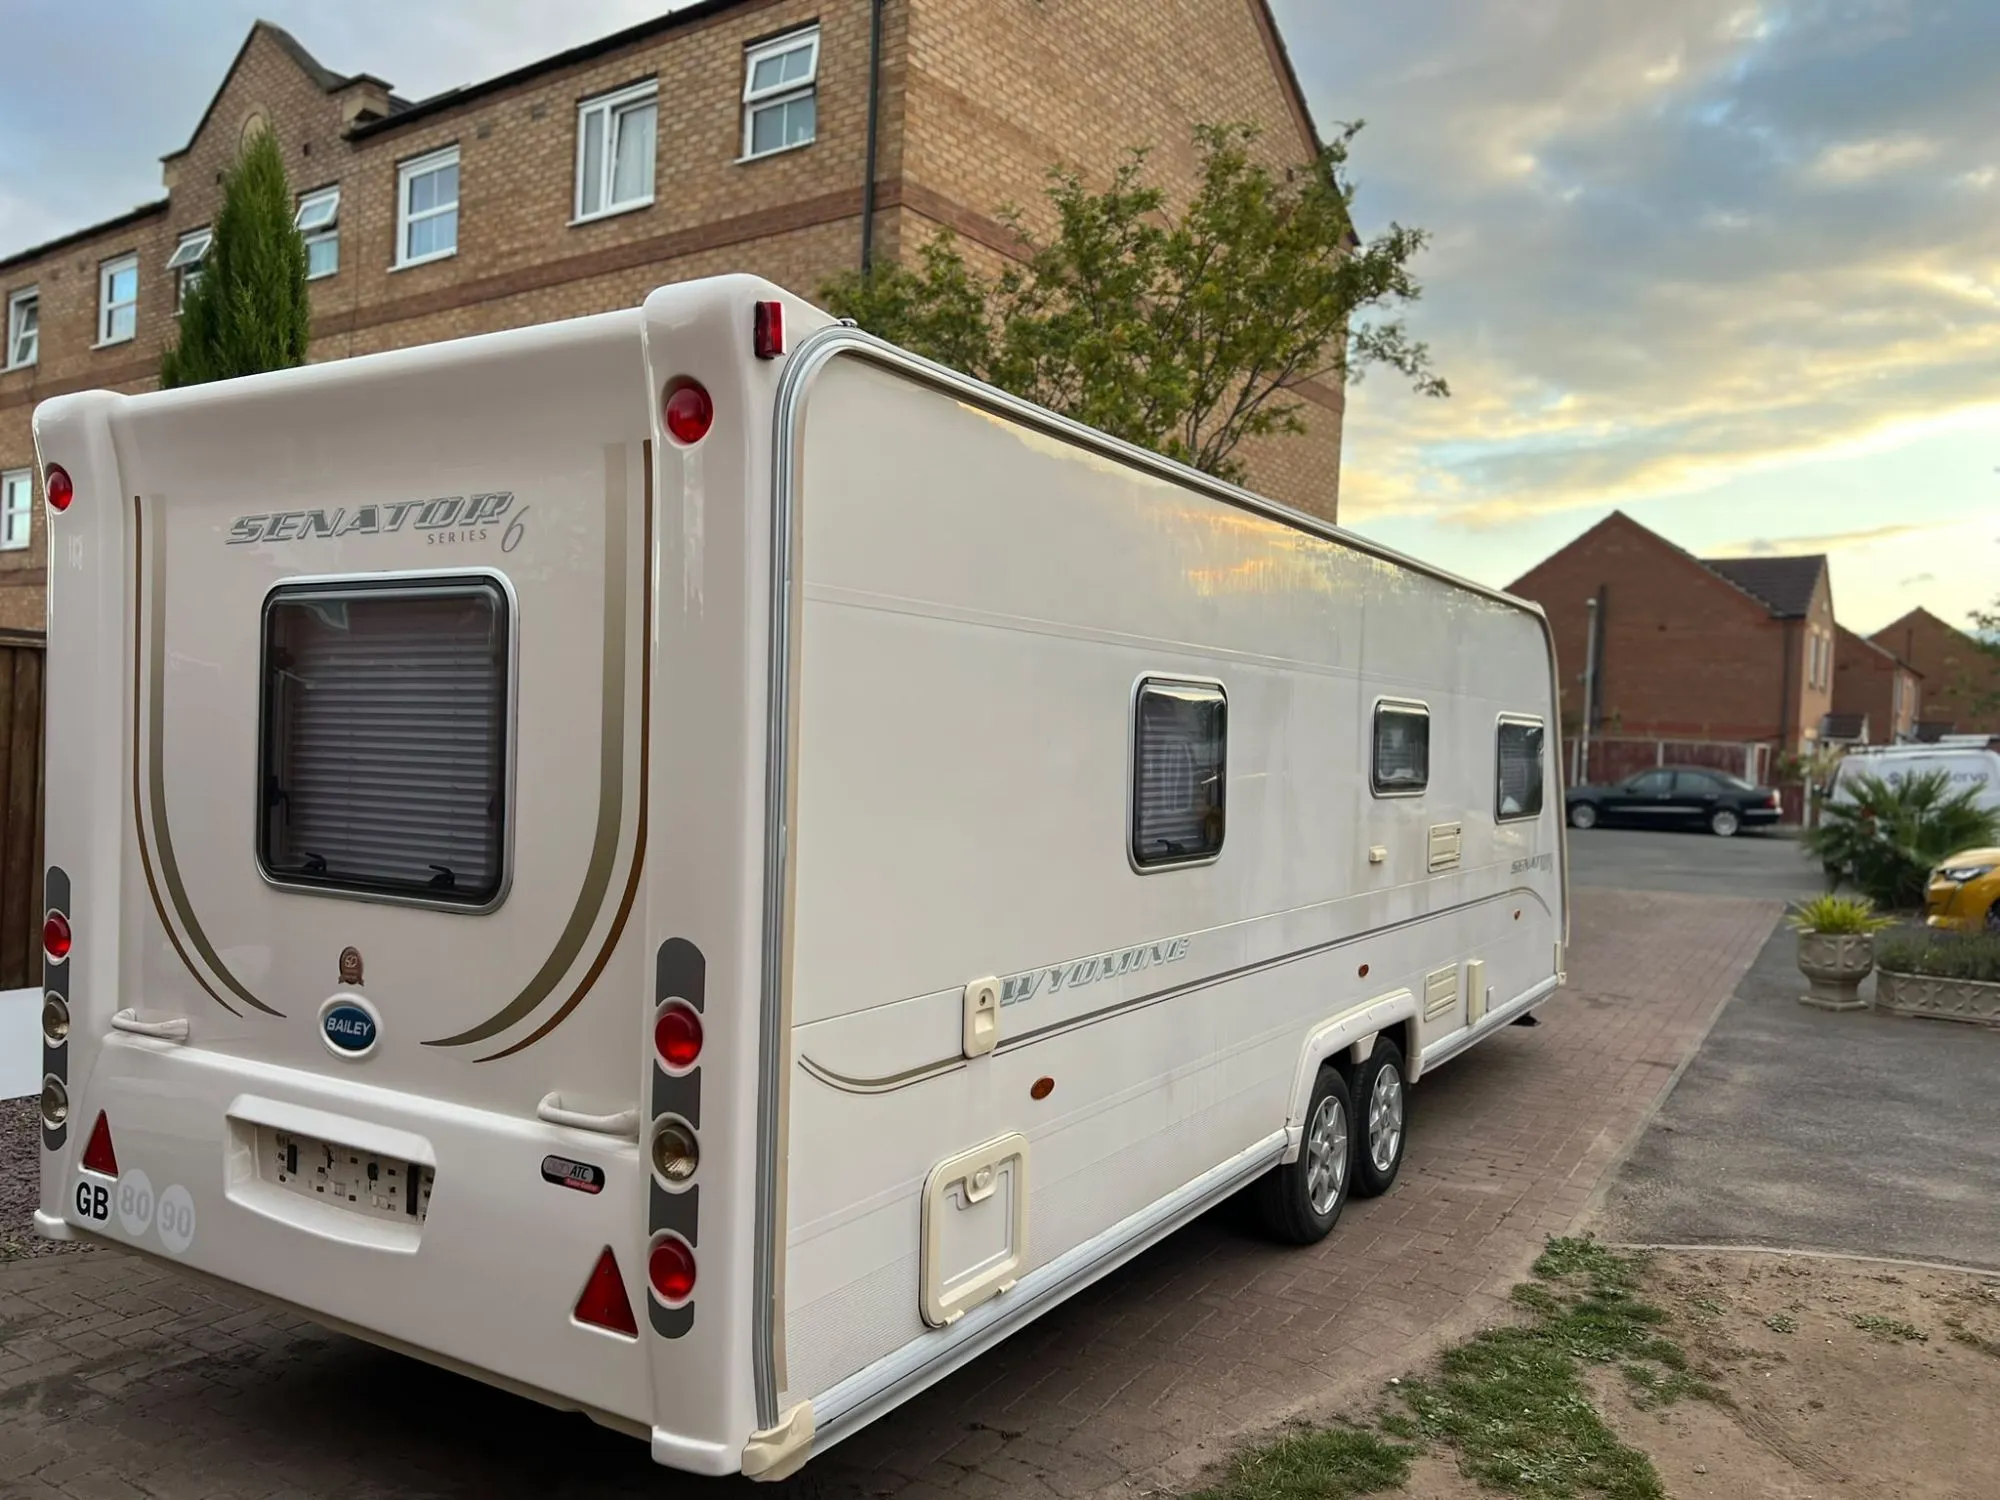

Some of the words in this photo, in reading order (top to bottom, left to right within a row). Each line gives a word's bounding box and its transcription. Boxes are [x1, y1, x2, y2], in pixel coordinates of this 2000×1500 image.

[225, 491, 514, 545] SENATOR
[427, 528, 487, 545] SERIES
[500, 505, 530, 553] 6
[999, 937, 1191, 1008] WYOMING
[327, 1017, 371, 1036] BAILEY
[569, 1165, 589, 1180] ATC
[76, 1181, 109, 1221] GB
[121, 1184, 148, 1222] 80
[161, 1199, 192, 1238] 90
